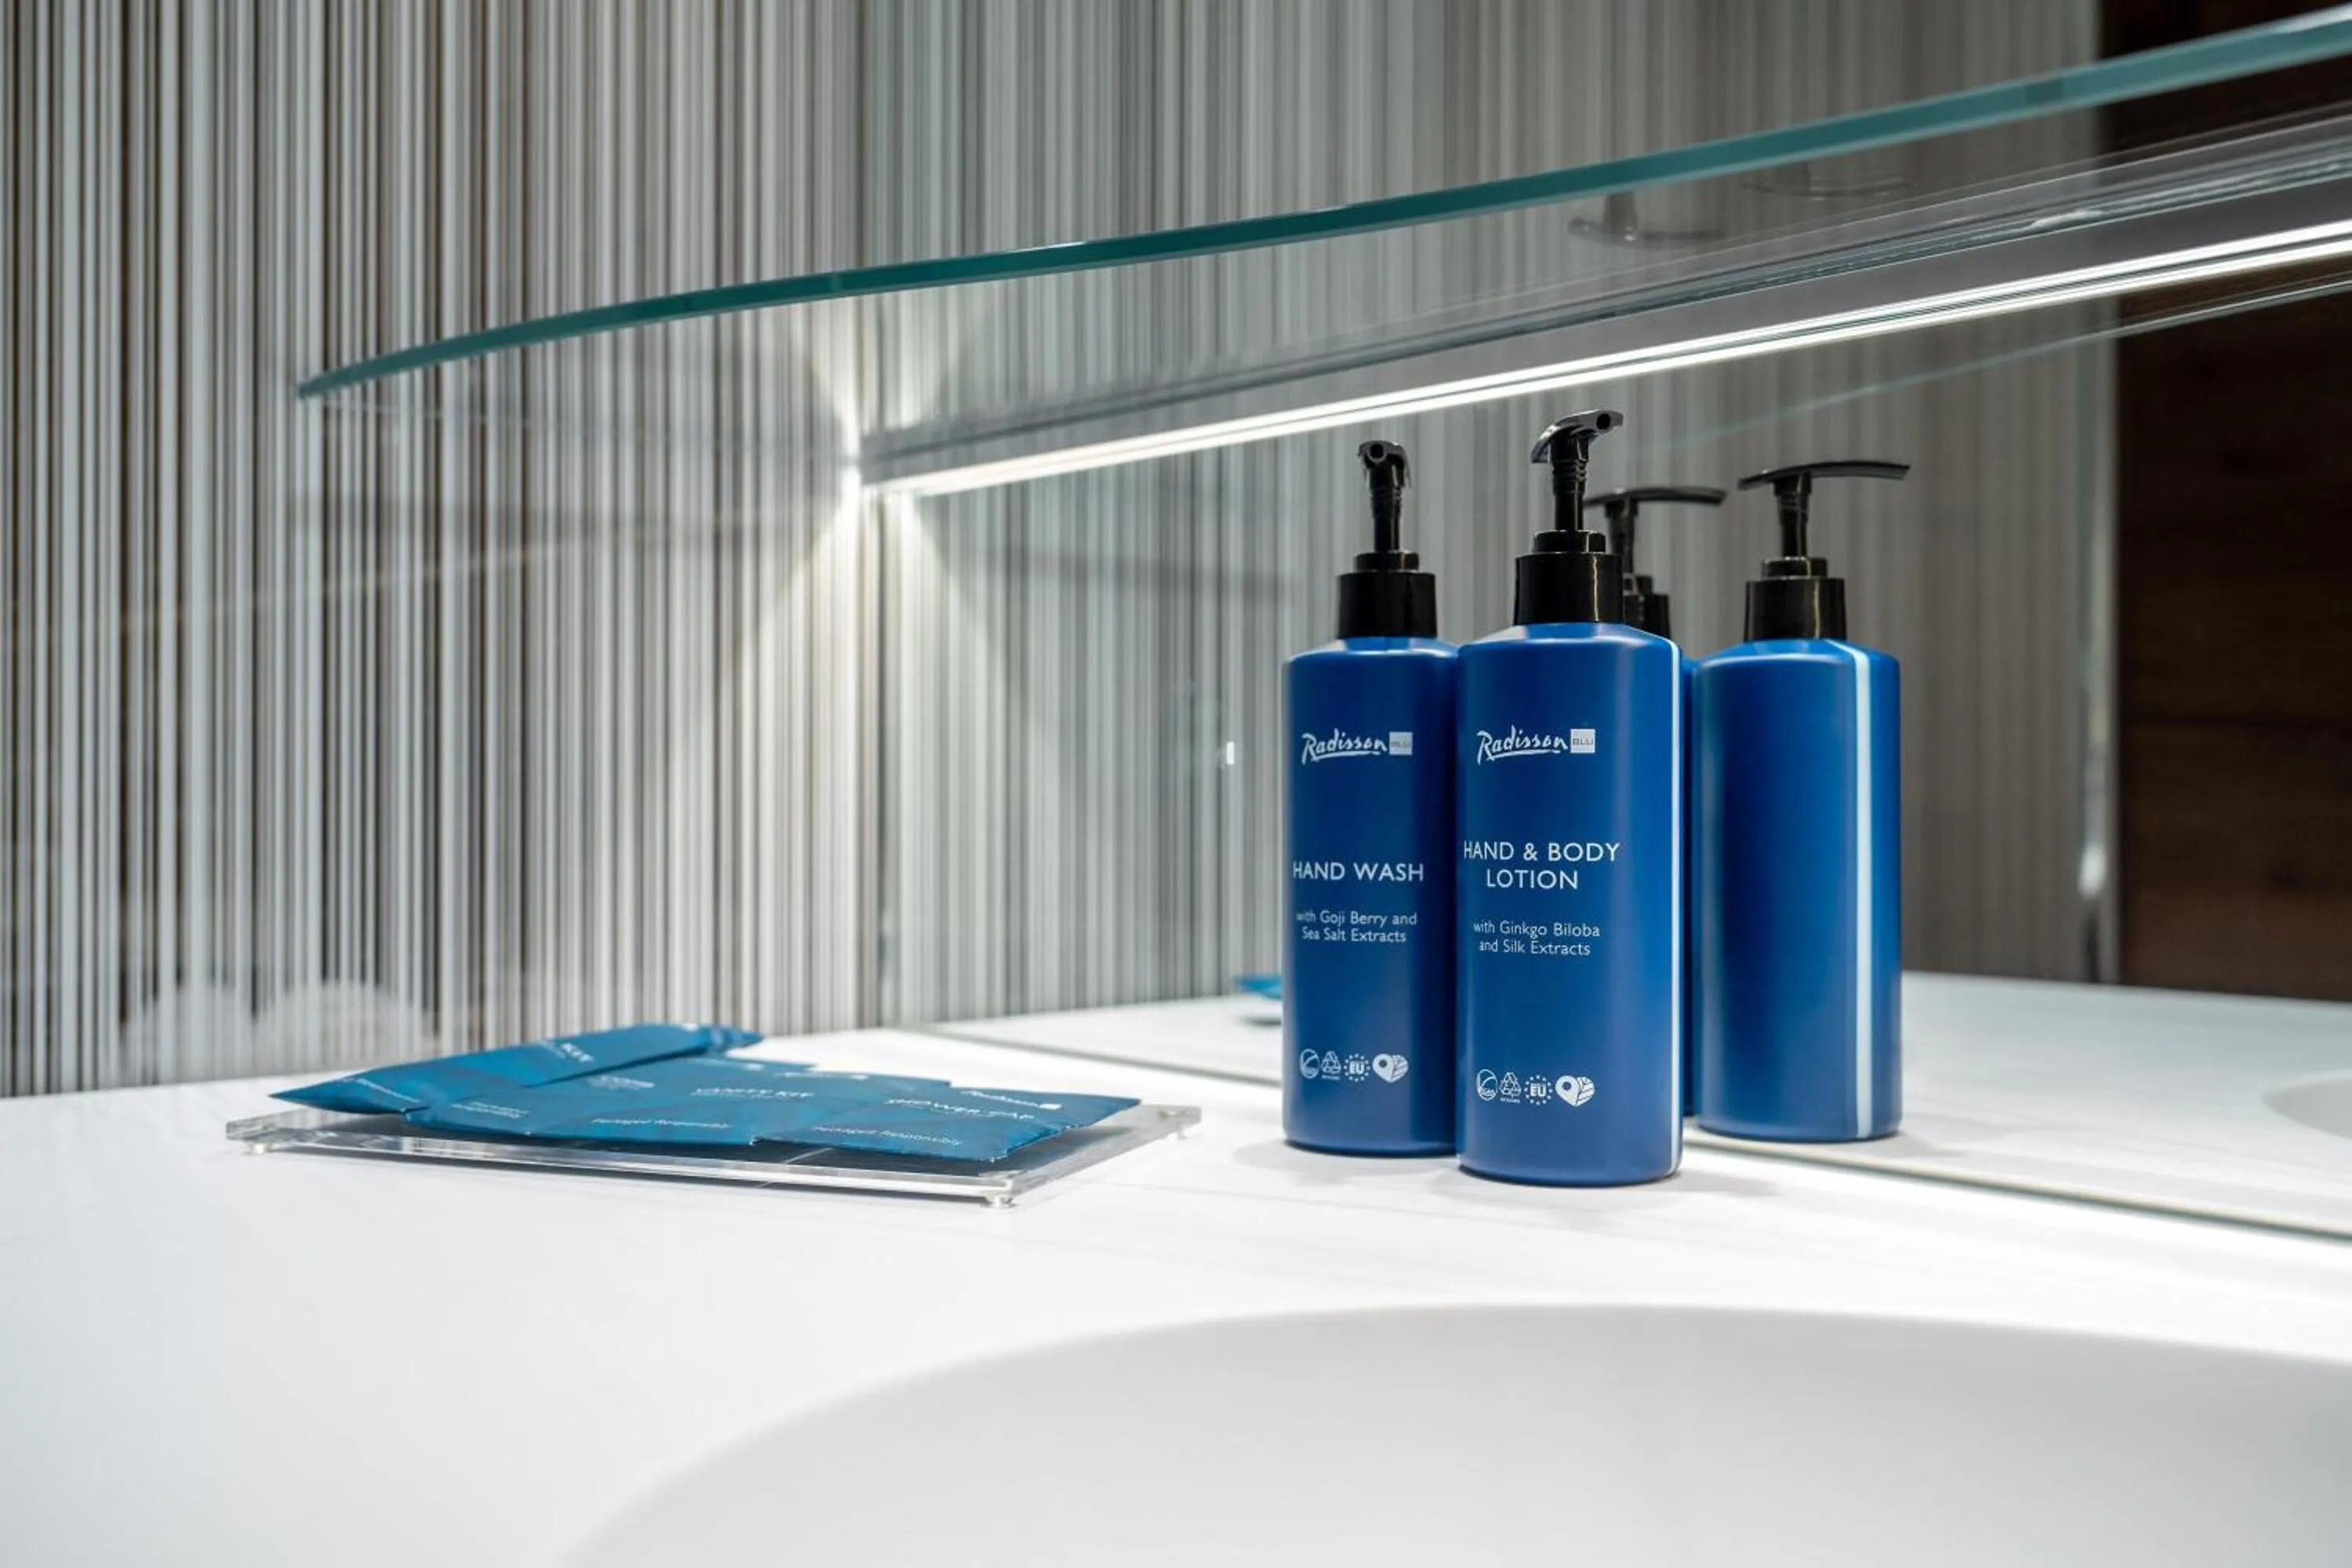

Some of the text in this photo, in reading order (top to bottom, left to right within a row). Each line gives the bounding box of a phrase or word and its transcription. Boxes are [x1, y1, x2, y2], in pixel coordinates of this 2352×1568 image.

[1301, 728, 1388, 765] Radisson
[1476, 724, 1569, 765] Radisson
[1464, 840, 1621, 862] HAND & BODY
[1292, 861, 1424, 882] HAND WASH
[1486, 868, 1578, 890] LOTION
[1295, 909, 1417, 929] with Goji Berry and
[1302, 926, 1406, 943] Sea Salt Extracts
[1473, 920, 1601, 939] with Ginkgo Biloba
[1479, 938, 1591, 956] and Silk Extracts
[1348, 1061, 1365, 1075] EU
[1530, 1083, 1547, 1097] EU
